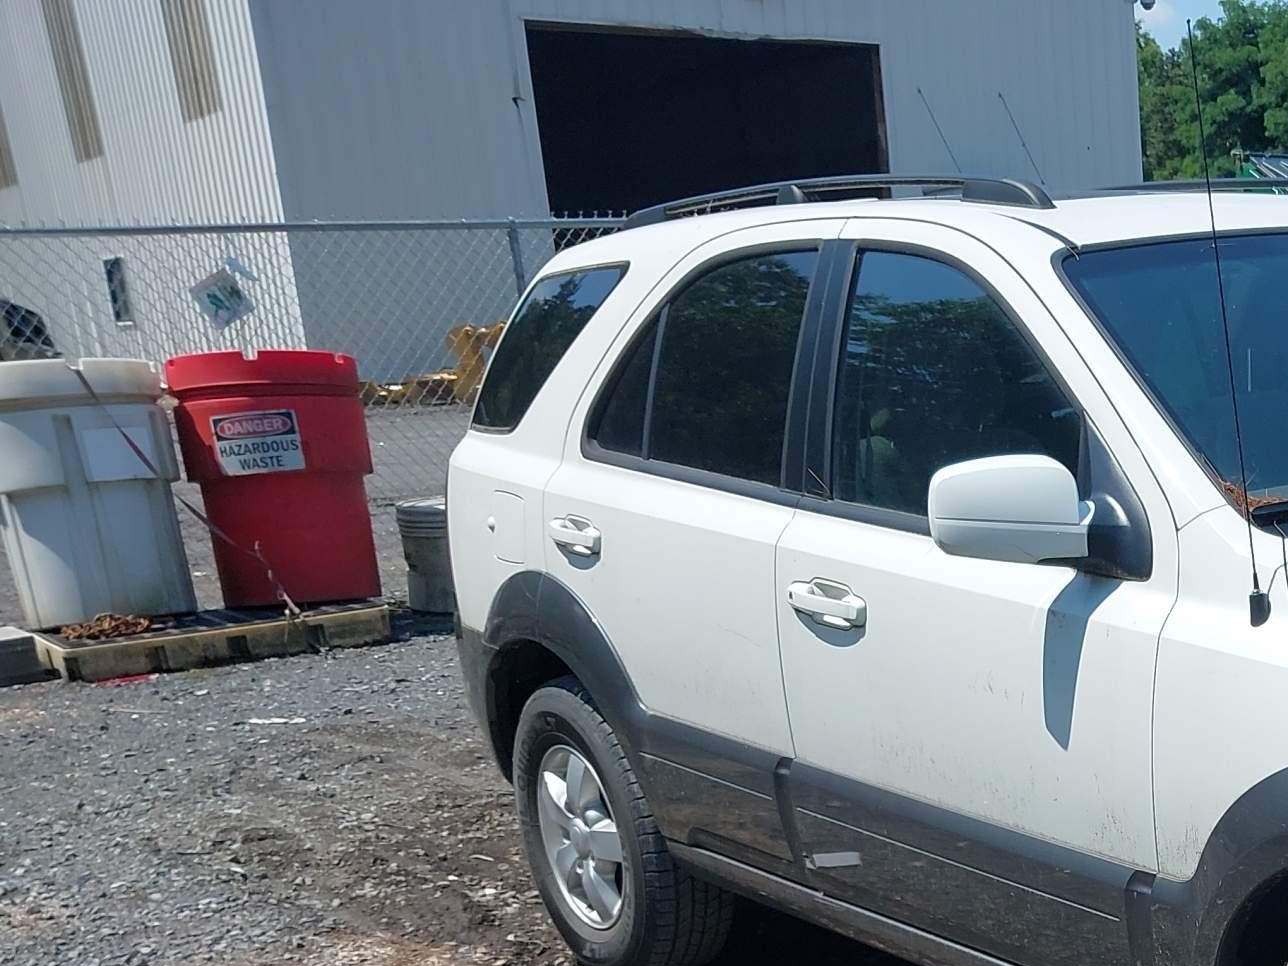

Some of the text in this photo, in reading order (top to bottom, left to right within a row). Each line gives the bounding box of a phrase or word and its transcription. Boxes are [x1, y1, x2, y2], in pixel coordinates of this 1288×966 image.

[223, 418, 283, 435] DANGER
[220, 439, 299, 458] HAZARDOUS
[238, 455, 285, 471] WASTE
